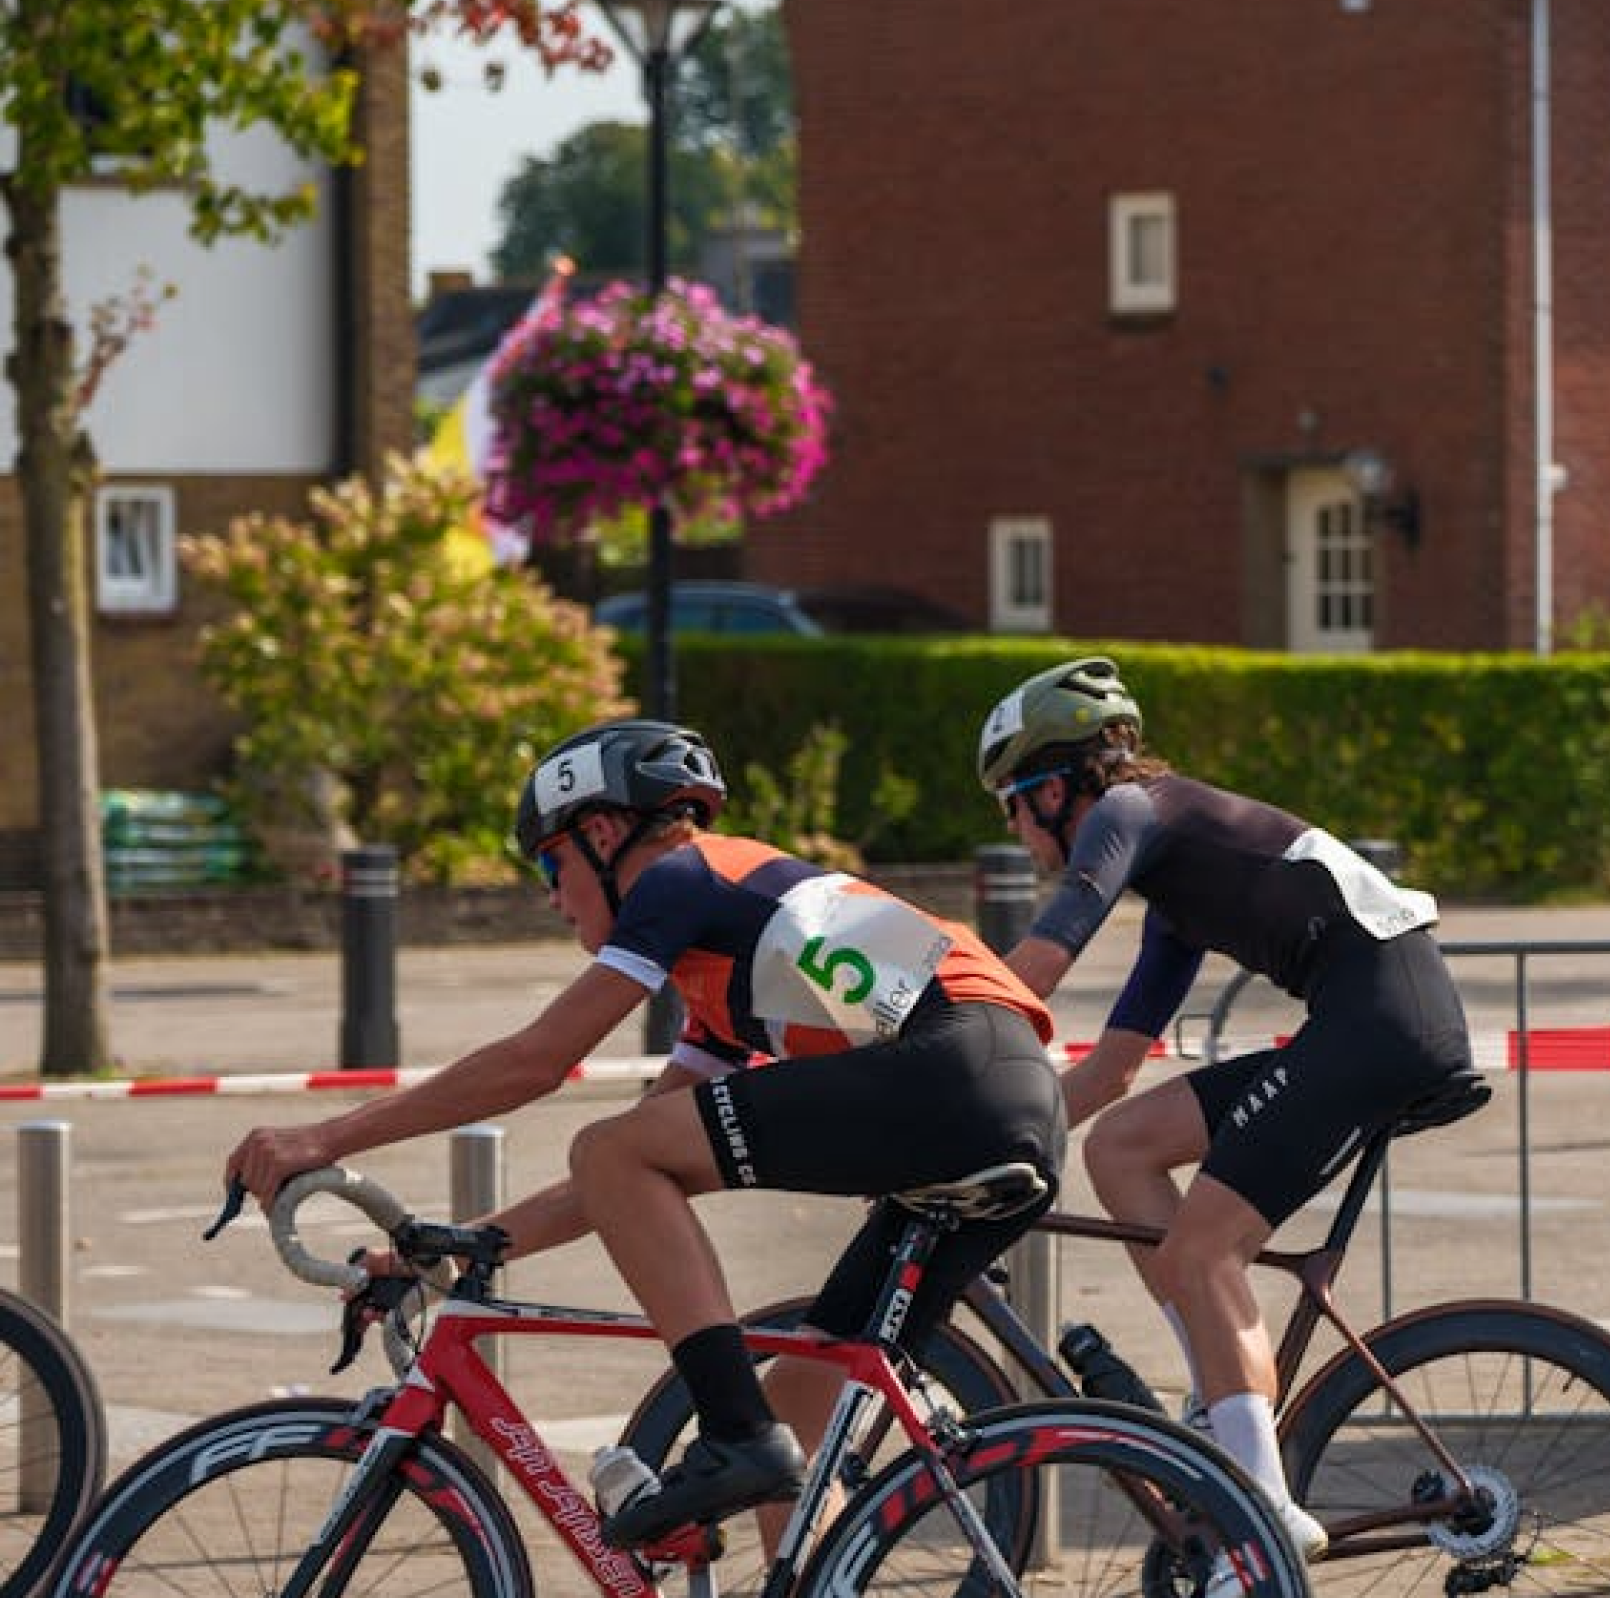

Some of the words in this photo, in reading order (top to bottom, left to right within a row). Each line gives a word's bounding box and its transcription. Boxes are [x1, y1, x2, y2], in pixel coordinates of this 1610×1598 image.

[558, 759, 575, 792] 5
[796, 934, 877, 1005] 5
[1232, 1066, 1289, 1129] MAAP
